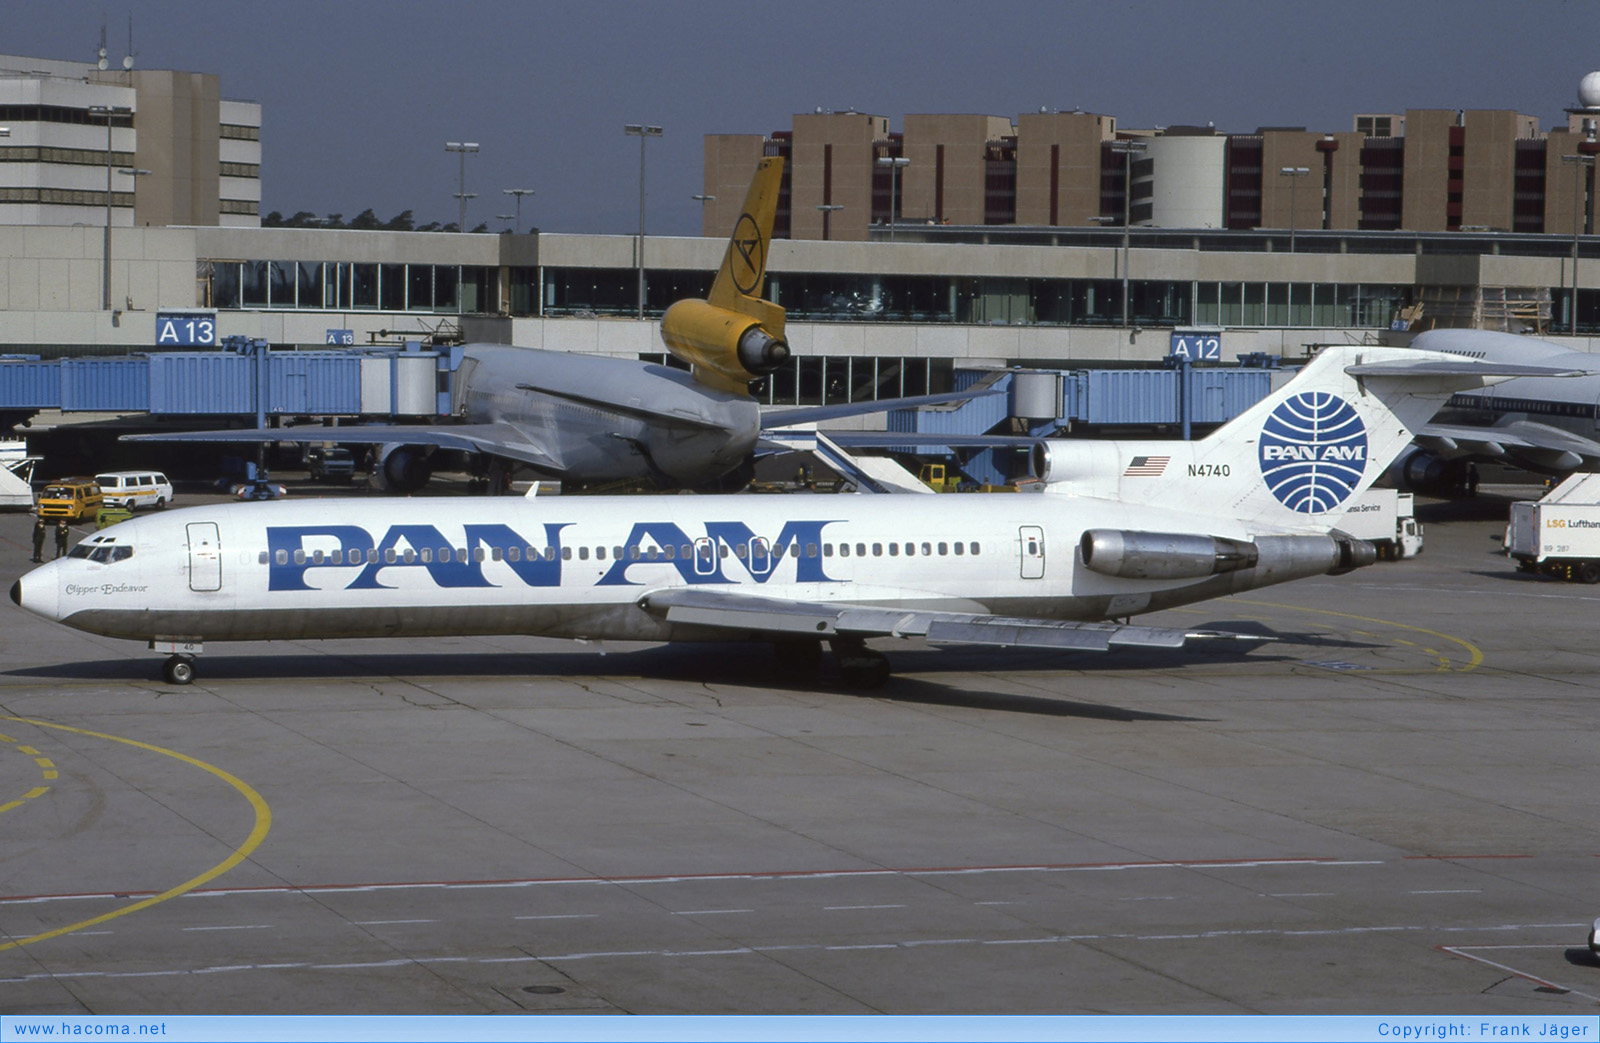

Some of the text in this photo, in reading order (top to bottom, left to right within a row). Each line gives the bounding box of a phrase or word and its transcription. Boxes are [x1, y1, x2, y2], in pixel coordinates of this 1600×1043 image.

[159, 321, 214, 343] A 13
[327, 334, 353, 345] A 13
[1175, 339, 1219, 359] A 12
[1263, 445, 1366, 461] PAN AM
[1188, 464, 1231, 477] N4740
[1361, 503, 1381, 512] Service
[1546, 519, 1566, 528] LSG
[266, 519, 853, 591] PAN AM
[65, 582, 148, 595] Clipper Endeavor
